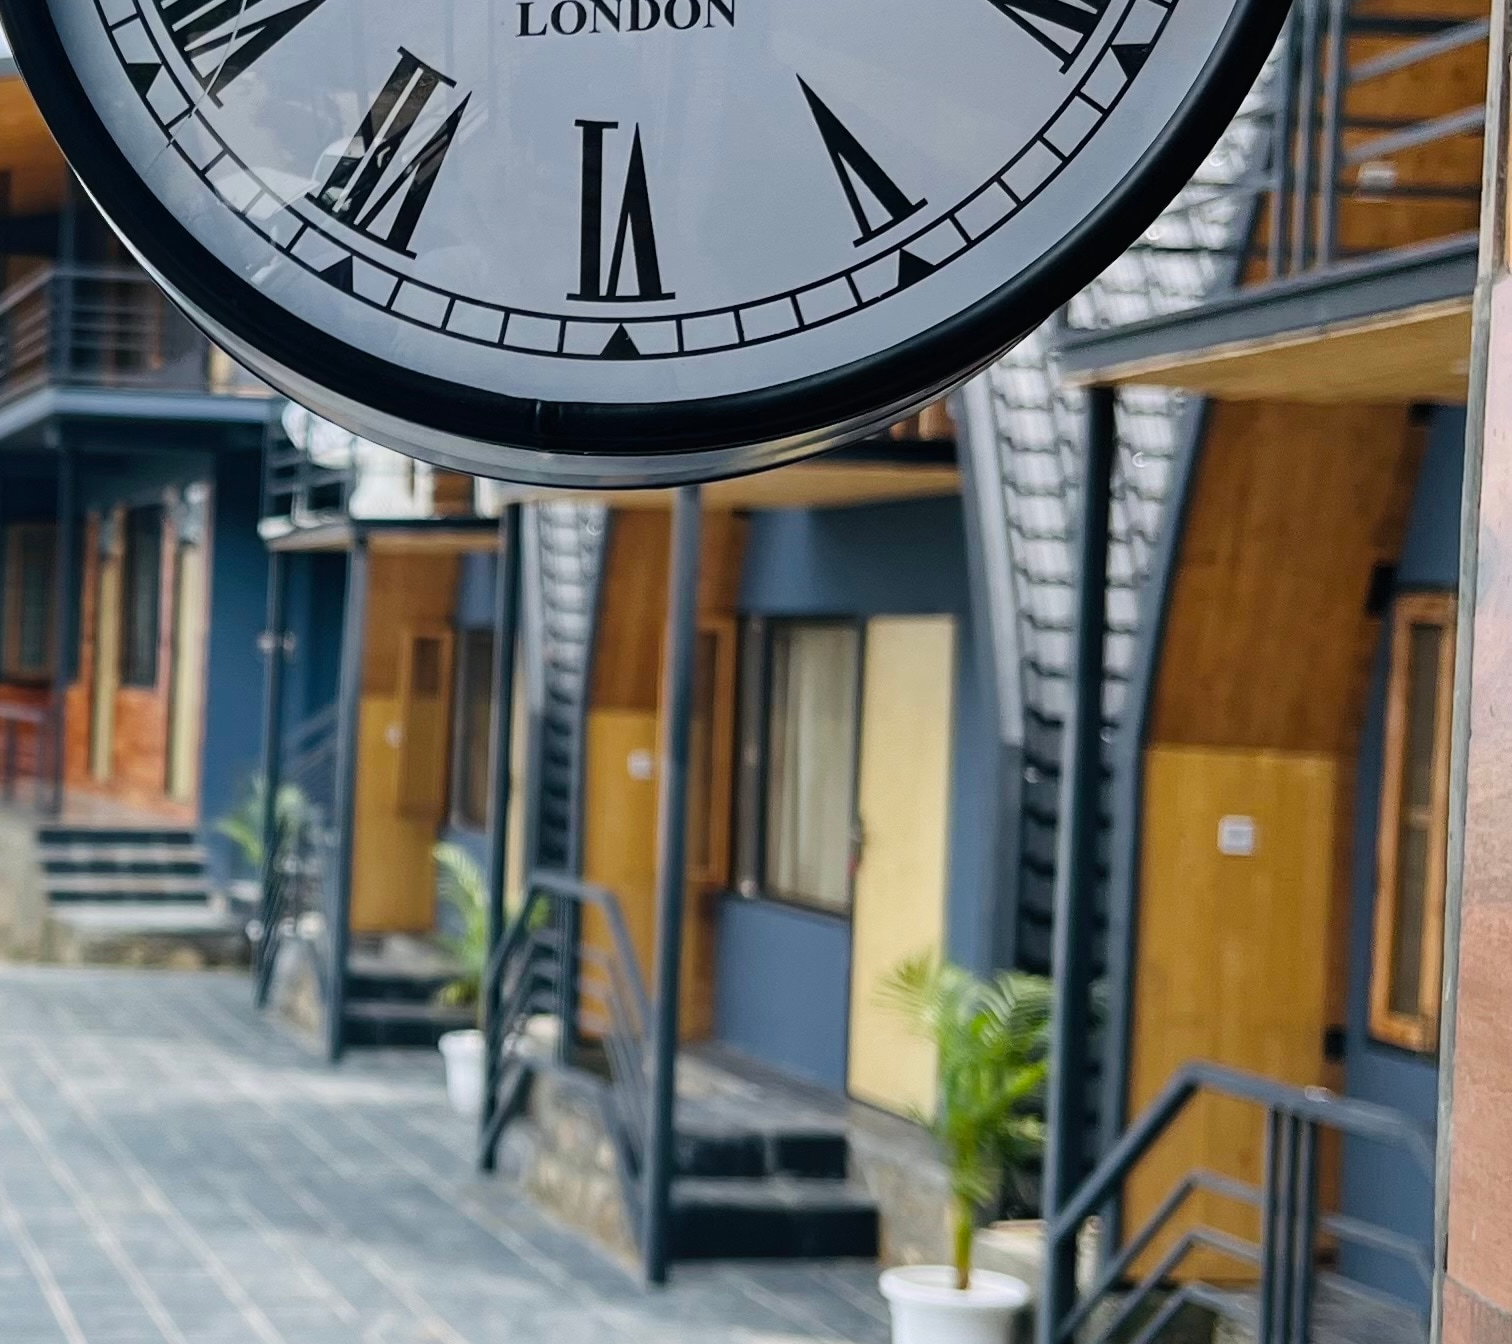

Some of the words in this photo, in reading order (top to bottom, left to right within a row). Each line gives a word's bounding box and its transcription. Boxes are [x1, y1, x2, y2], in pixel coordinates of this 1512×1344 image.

[304, 46, 473, 260] VII
[565, 119, 677, 302] VI
[795, 72, 929, 249] V
